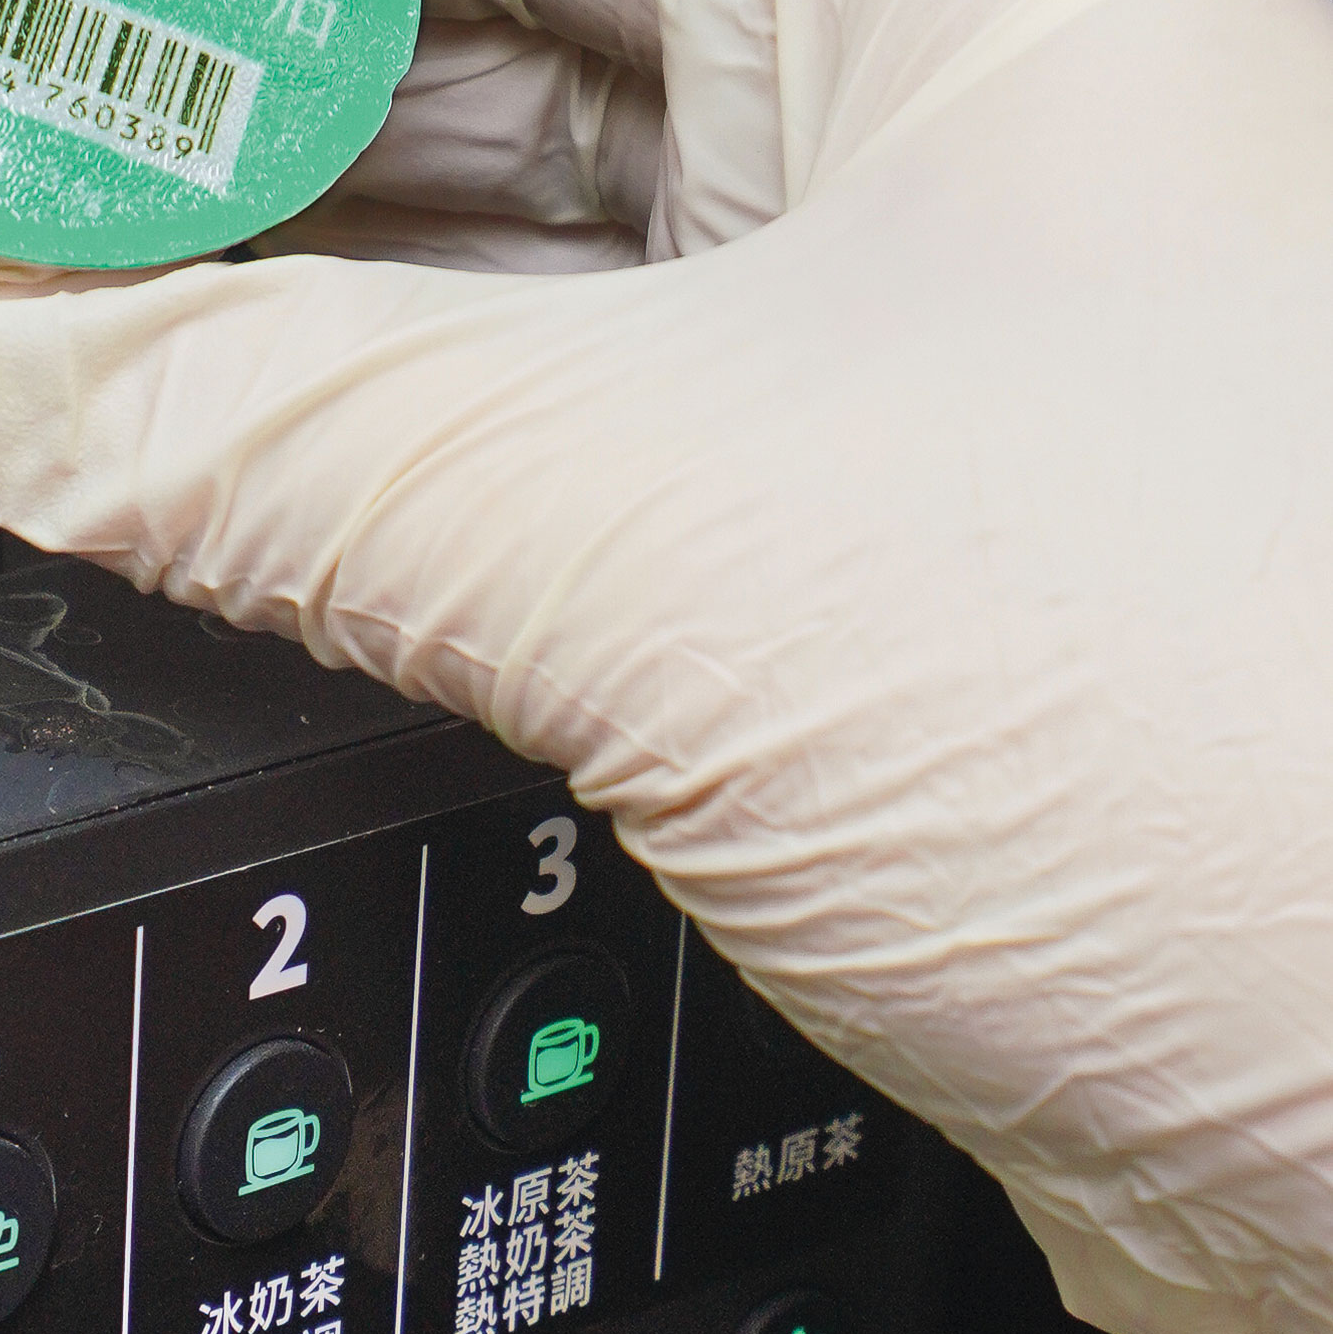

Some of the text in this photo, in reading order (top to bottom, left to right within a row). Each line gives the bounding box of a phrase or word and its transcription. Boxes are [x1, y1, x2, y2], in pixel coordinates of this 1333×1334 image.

[520, 816, 578, 916] 3
[248, 893, 308, 1001] 2
[460, 1152, 600, 1238] 冰原茶
[732, 1113, 863, 1201] 熱原茶
[457, 1204, 596, 1297] 熱奶茶
